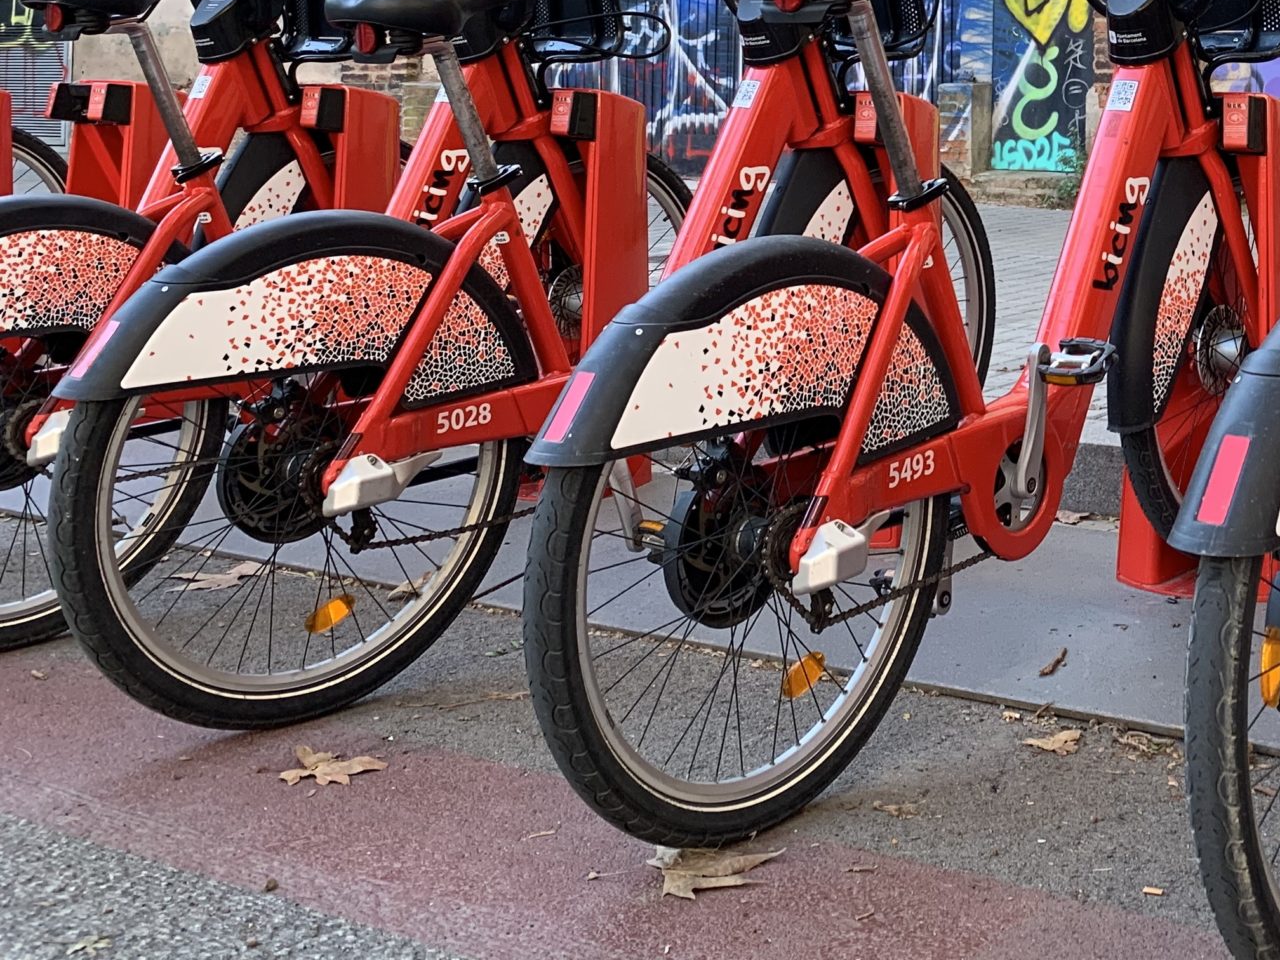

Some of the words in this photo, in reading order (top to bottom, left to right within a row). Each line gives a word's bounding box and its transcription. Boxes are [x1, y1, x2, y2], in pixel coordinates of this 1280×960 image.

[1091, 176, 1151, 291] bicing
[436, 402, 492, 434] 5028
[888, 449, 935, 489] 5493
